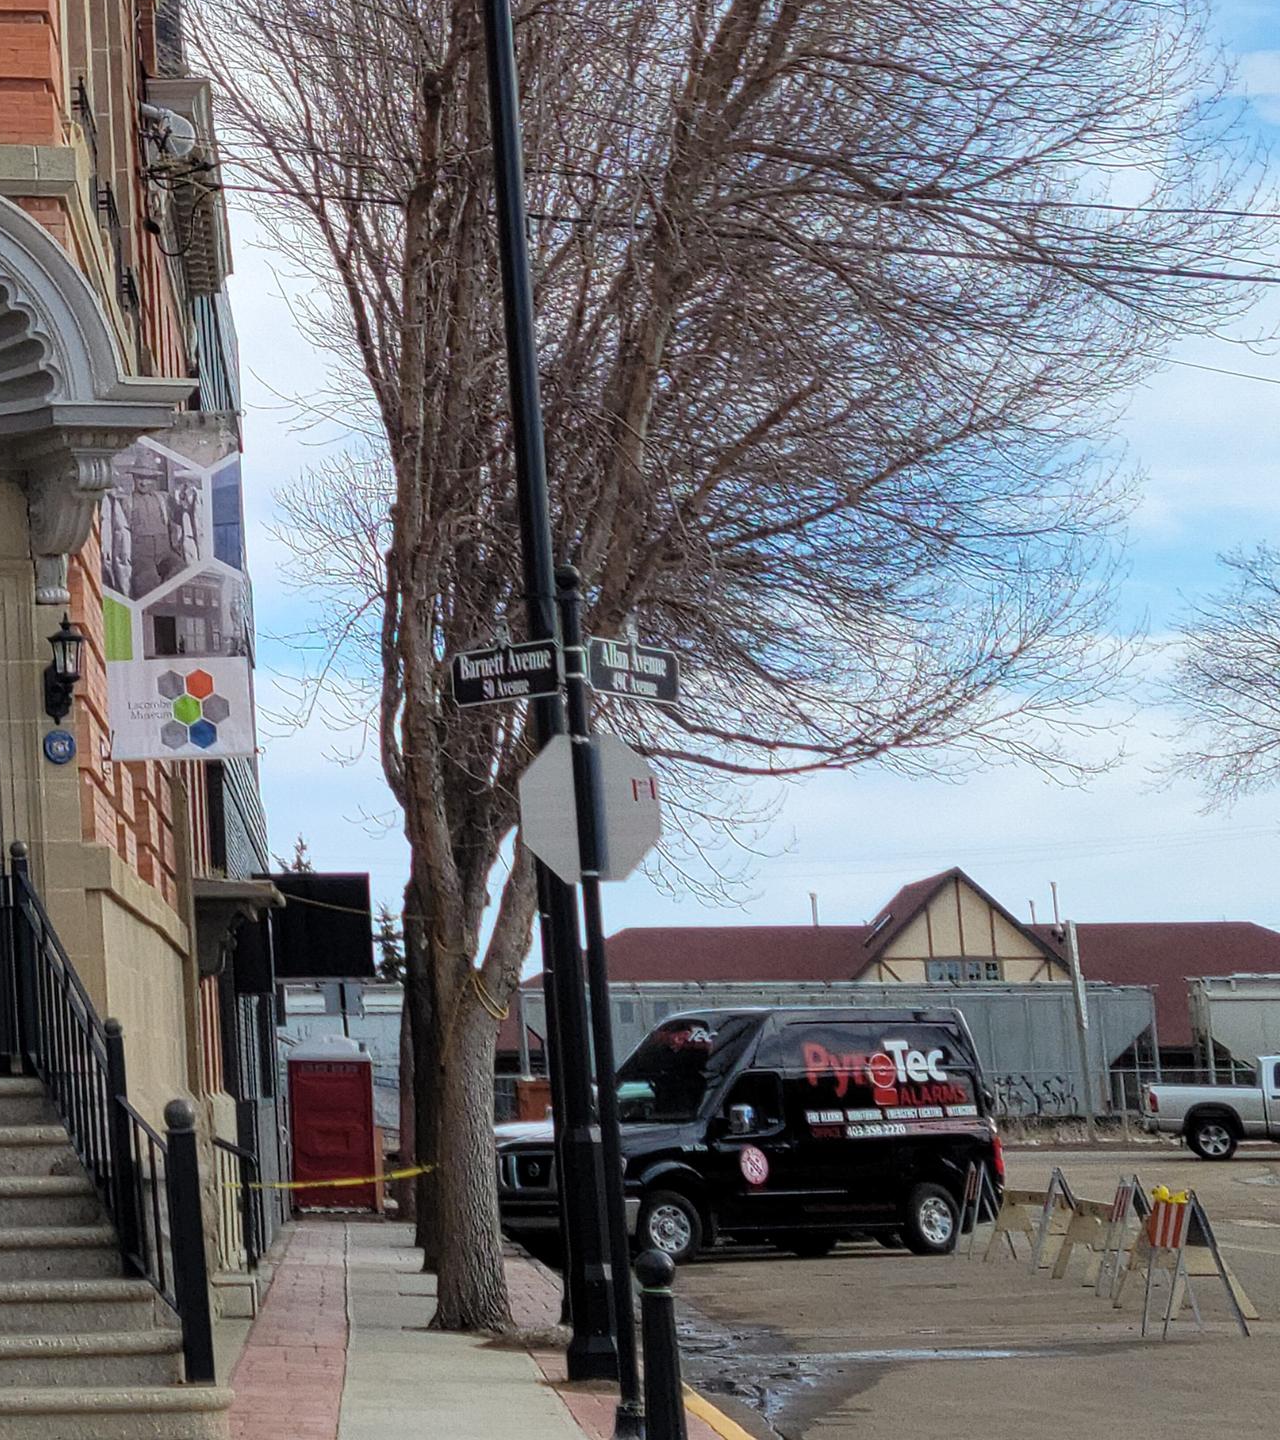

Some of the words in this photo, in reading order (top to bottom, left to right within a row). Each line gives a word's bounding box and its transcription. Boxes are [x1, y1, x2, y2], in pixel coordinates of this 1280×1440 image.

[459, 649, 505, 681] Barnett
[507, 646, 552, 674] Avenue
[631, 647, 668, 678] Avenue
[496, 677, 531, 697] Avenue
[629, 675, 659, 698] Avenue
[127, 700, 172, 711] Lacombe
[130, 710, 174, 721] Museum
[899, 1085, 969, 1106] ALARMS
